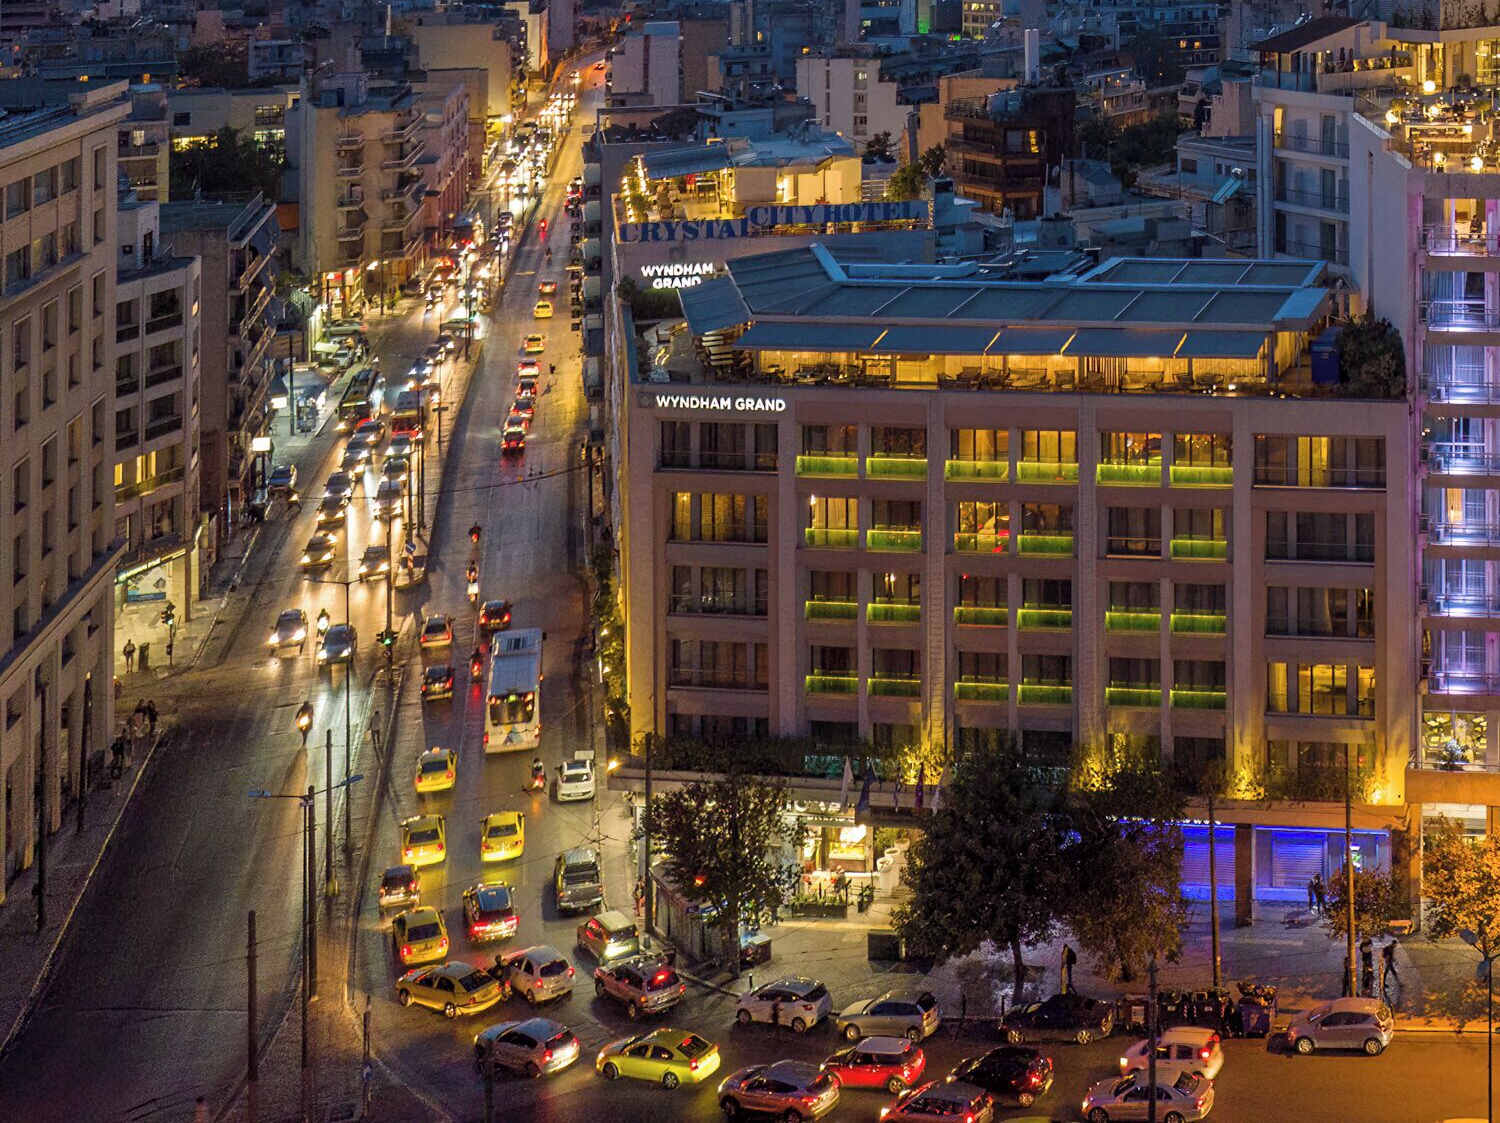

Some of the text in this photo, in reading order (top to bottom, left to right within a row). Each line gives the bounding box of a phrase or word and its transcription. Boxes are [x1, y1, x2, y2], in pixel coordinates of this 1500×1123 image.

[750, 204, 819, 226] CITY
[822, 201, 919, 222] HOTEL
[640, 262, 714, 276] WYNDHAM
[652, 276, 702, 289] GRAND
[656, 395, 732, 410] WYNDHAM
[735, 397, 786, 412] GRAND
